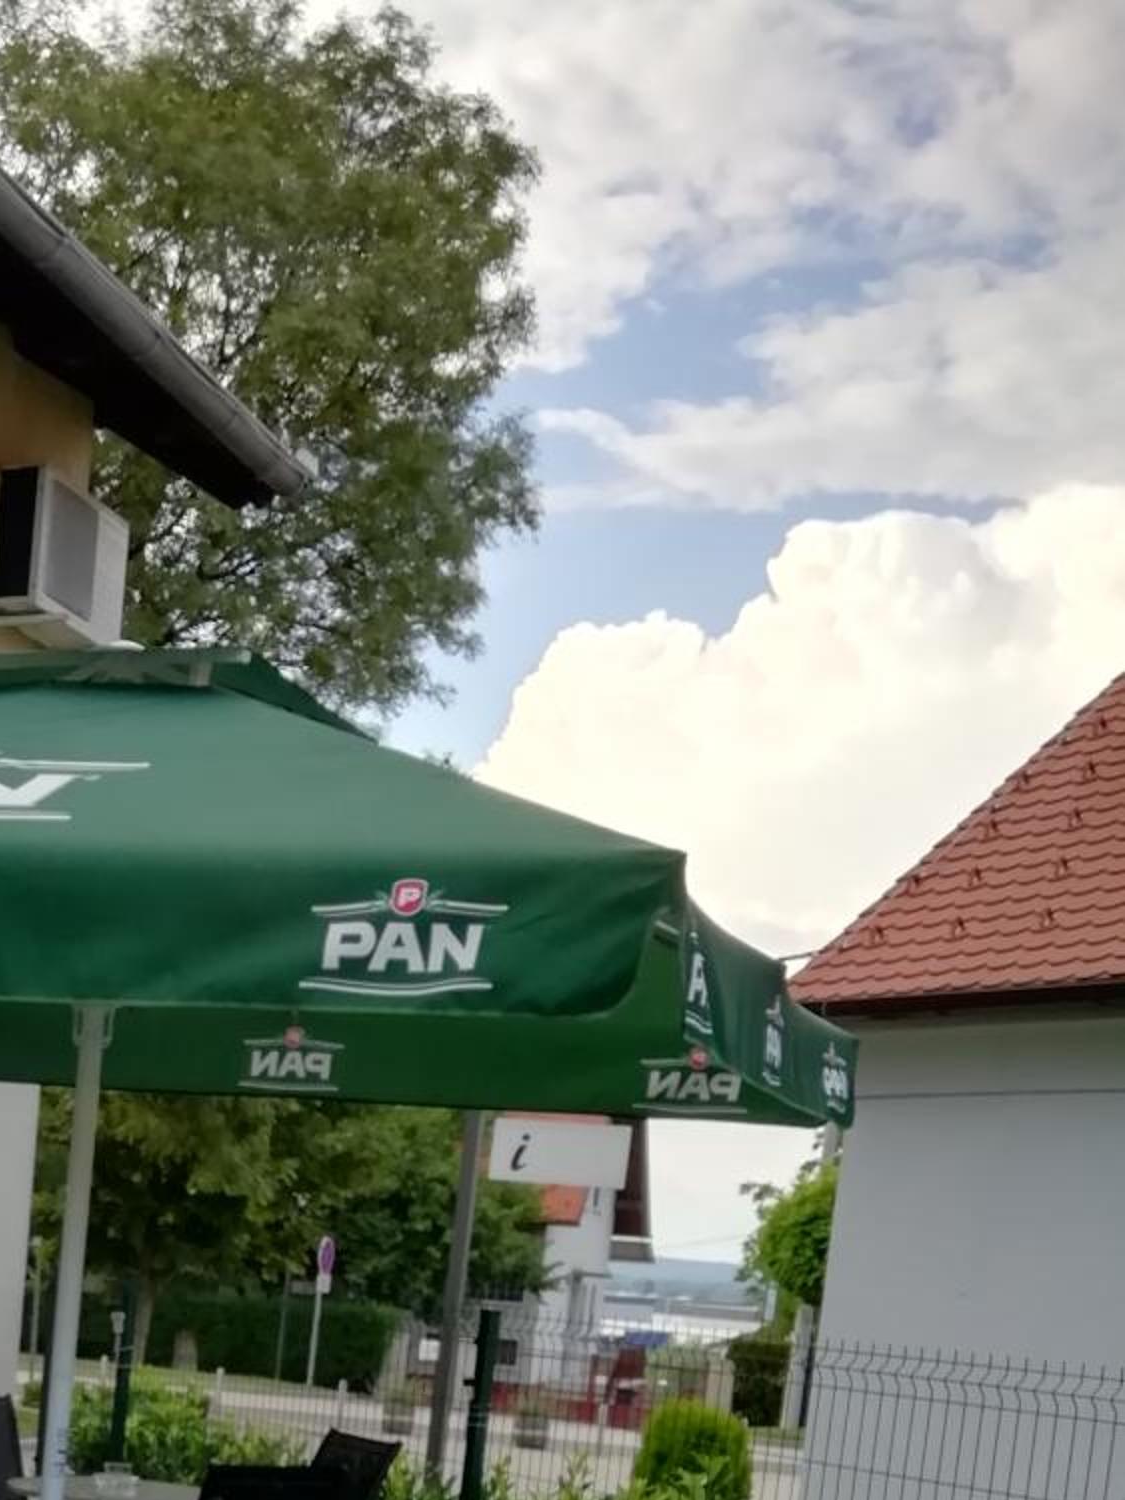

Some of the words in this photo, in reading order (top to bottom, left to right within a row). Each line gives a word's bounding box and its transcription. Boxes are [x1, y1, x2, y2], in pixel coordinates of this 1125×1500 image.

[397, 887, 422, 907] P
[321, 920, 485, 973] PAN
[510, 1133, 531, 1171] i
